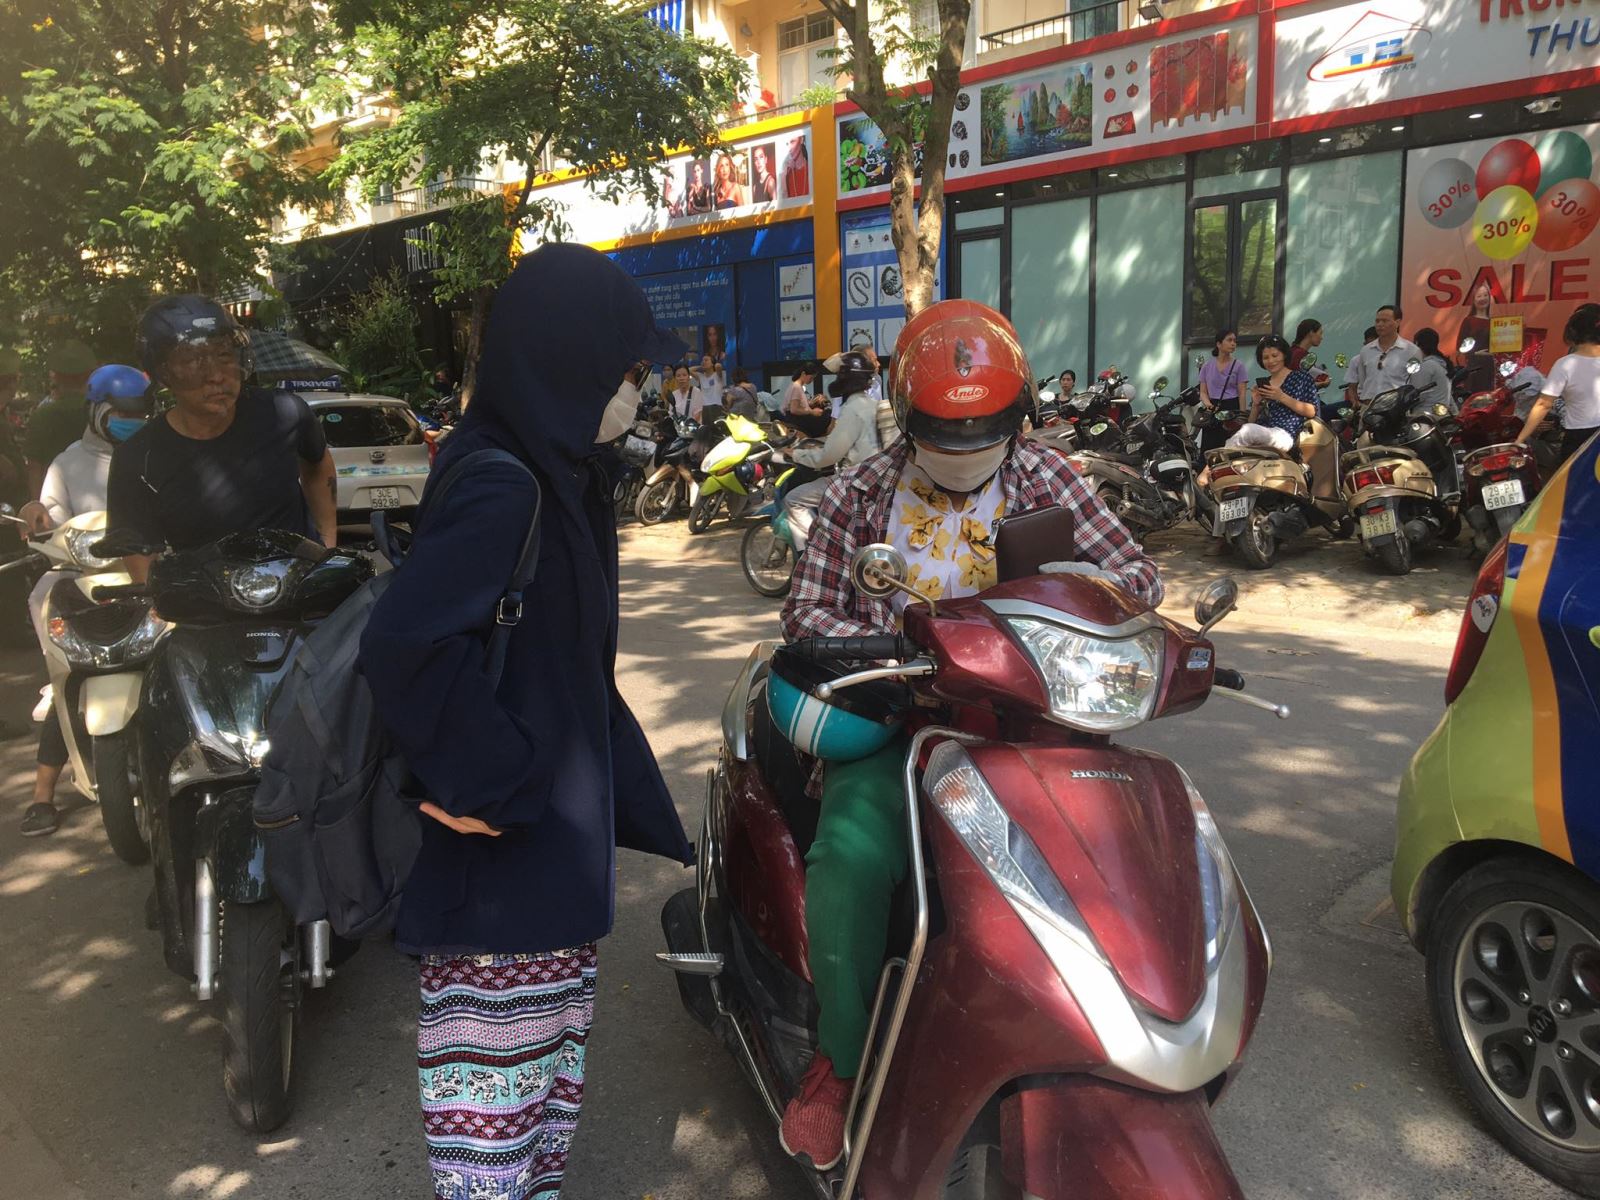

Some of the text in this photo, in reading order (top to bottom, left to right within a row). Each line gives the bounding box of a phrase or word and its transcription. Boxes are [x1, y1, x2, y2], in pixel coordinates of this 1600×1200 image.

[1428, 180, 1472, 218] 30%
[1551, 192, 1593, 231] 30%
[1483, 216, 1531, 240] 30%
[1425, 258, 1590, 309] SALE
[1071, 769, 1134, 781] HONDA
